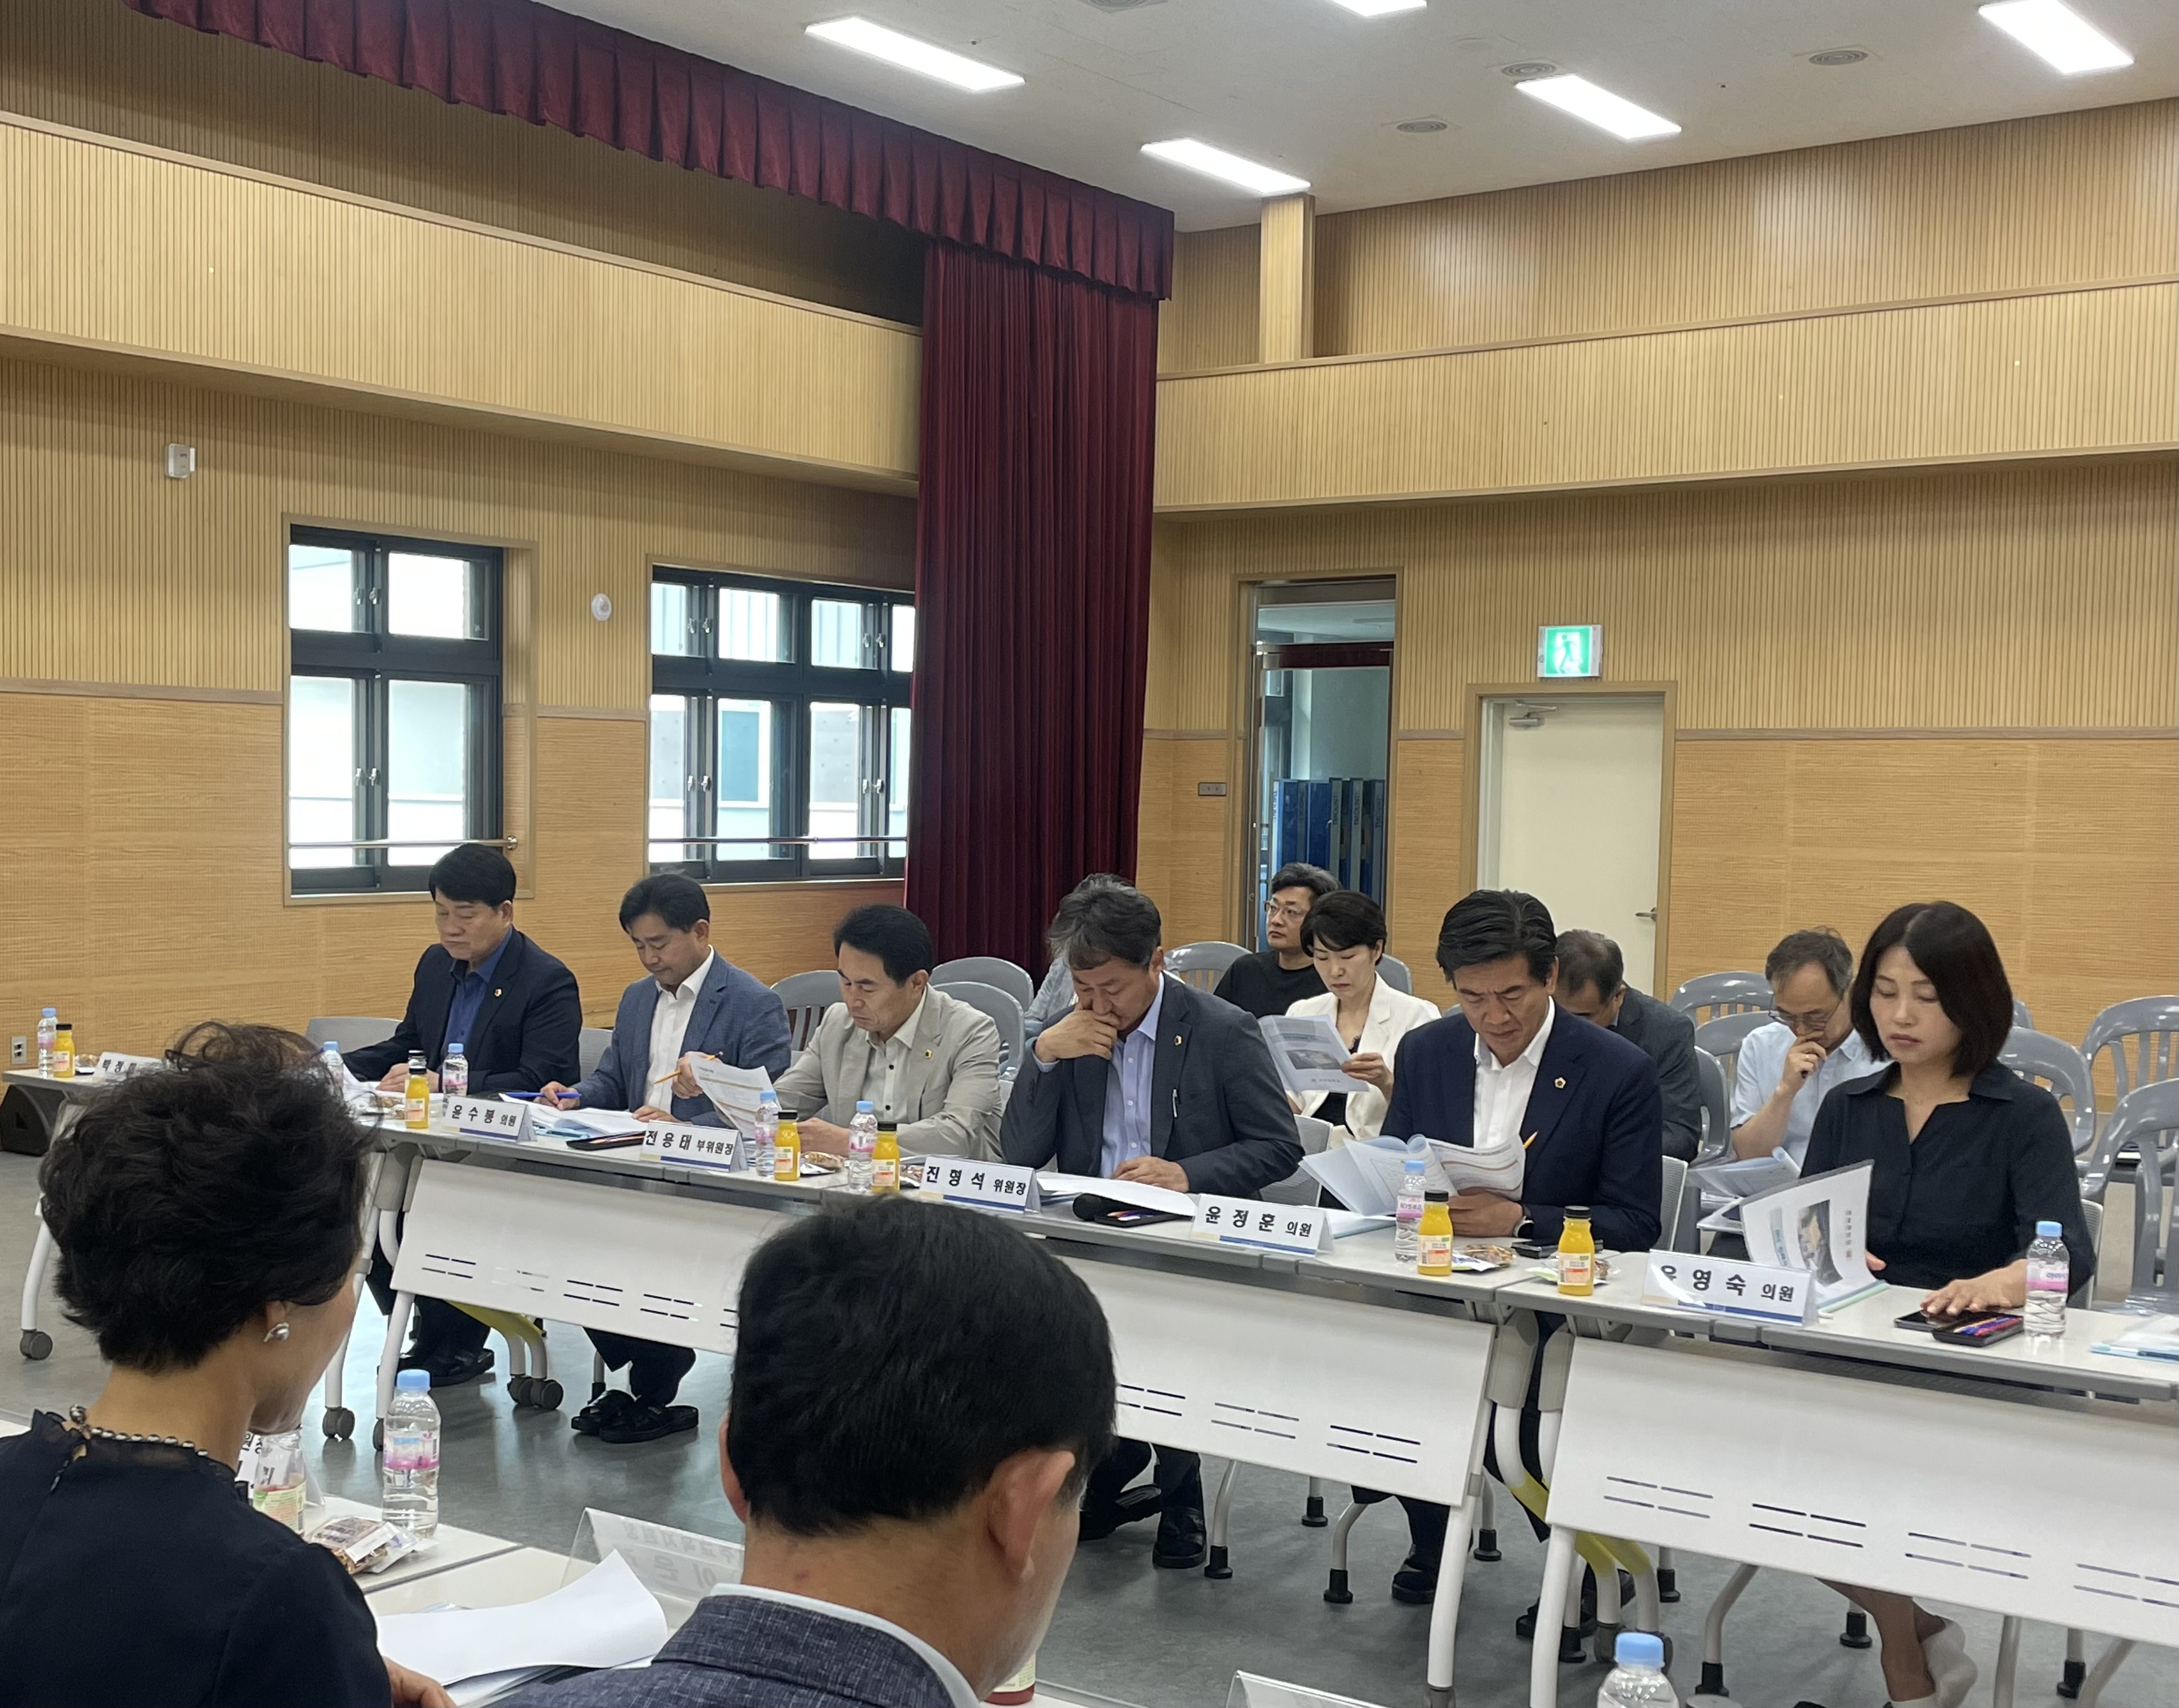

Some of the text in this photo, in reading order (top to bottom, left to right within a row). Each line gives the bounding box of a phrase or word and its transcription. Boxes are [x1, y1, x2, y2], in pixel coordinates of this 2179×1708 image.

[451, 1105, 517, 1127] 윤수봉 의원
[645, 1131, 734, 1156] 전용태 부위원장
[927, 1166, 1026, 1195] 진형석 위원장
[1205, 1206, 1312, 1237] 윤정훈 의원
[1761, 1284, 1794, 1302] 의원
